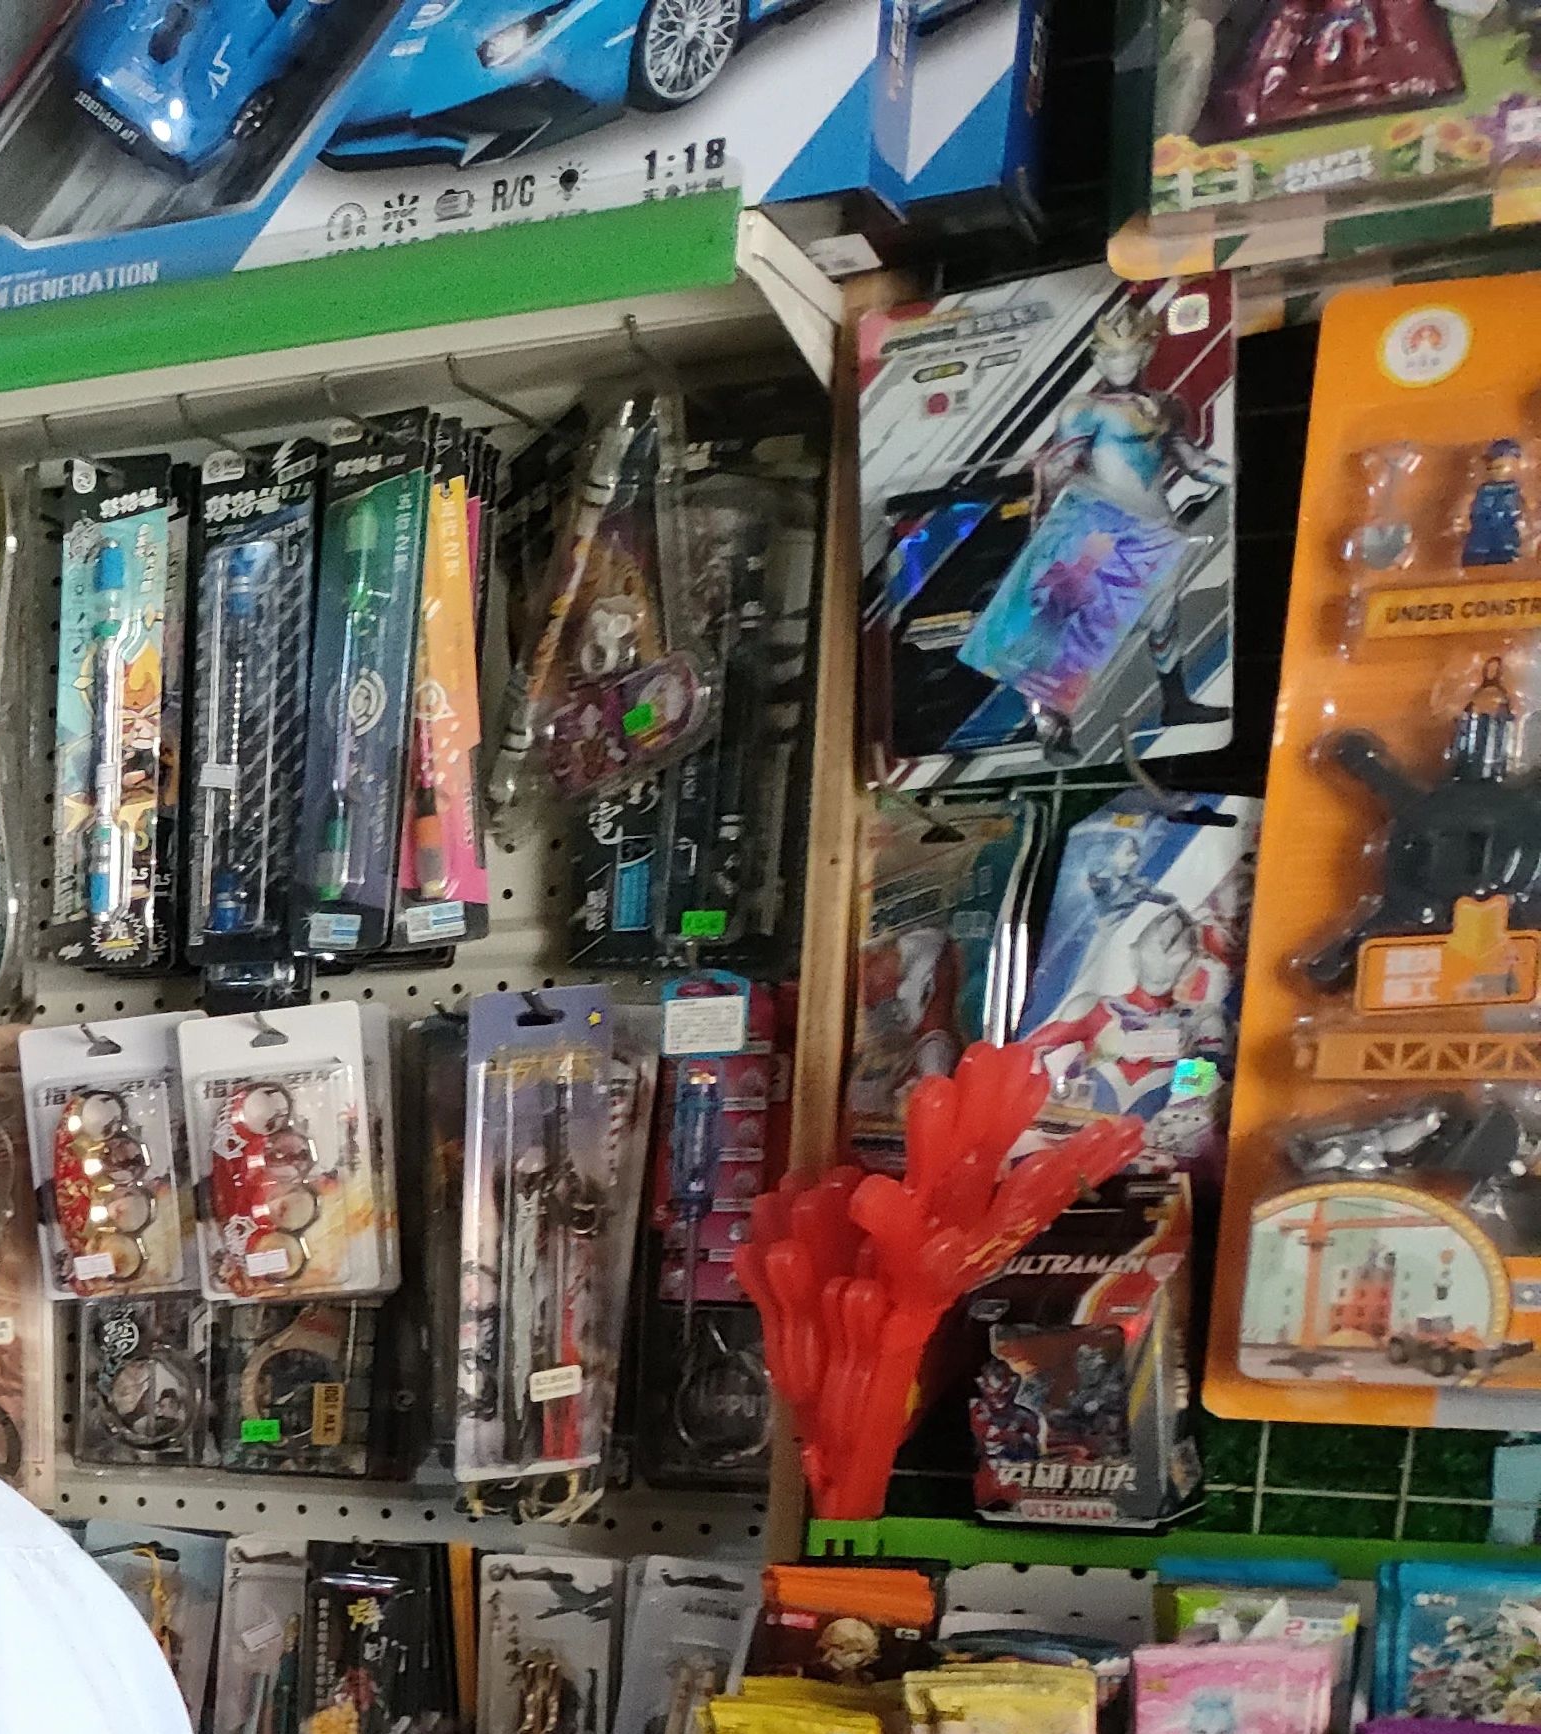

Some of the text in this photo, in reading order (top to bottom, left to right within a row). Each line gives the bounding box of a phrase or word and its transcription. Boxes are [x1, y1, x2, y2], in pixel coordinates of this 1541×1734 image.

[644, 137, 726, 181] 1:18
[492, 176, 537, 213] R/C
[24, 262, 159, 305] GENERATION
[1386, 602, 1454, 624] UNDER
[1004, 1253, 1145, 1276] ULTRAMAN
